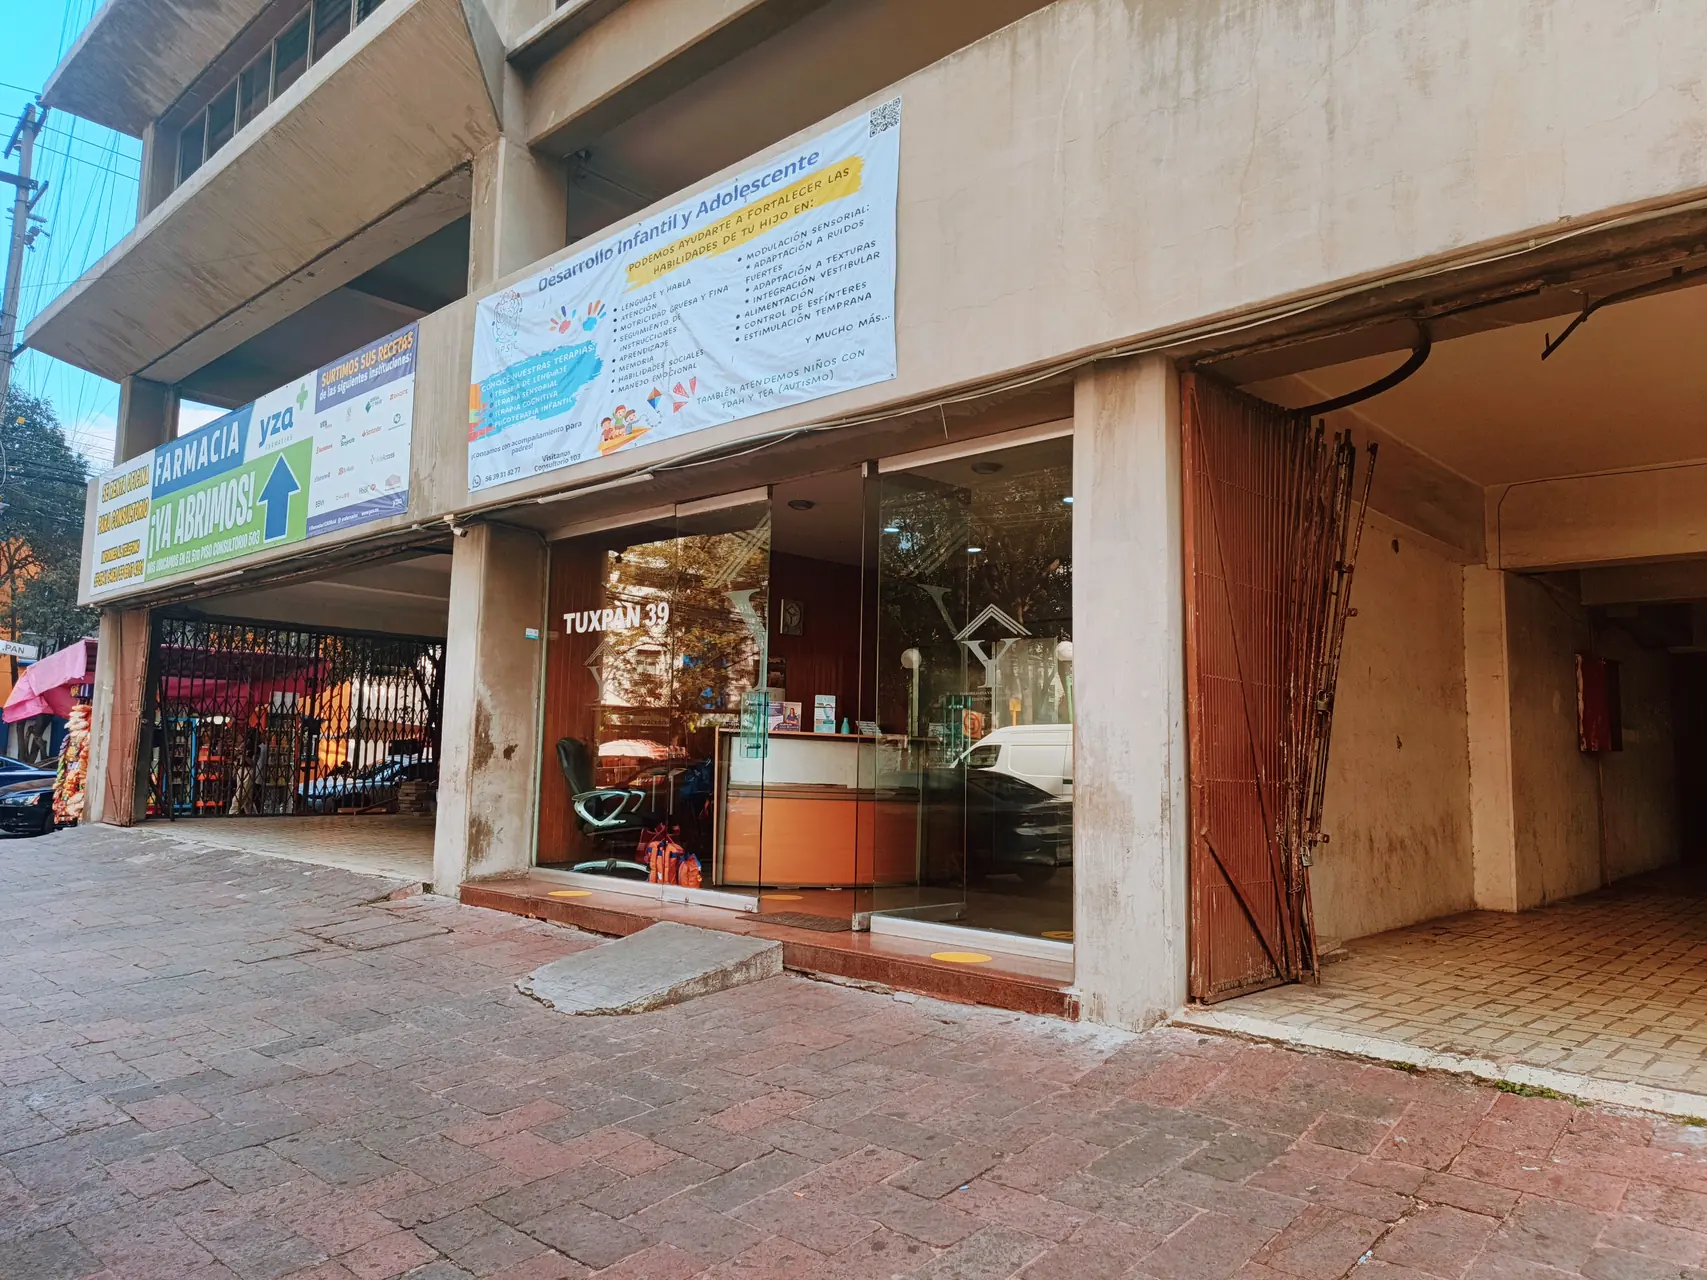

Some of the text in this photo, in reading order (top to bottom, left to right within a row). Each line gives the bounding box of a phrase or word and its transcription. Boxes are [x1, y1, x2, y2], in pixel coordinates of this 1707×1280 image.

[538, 151, 820, 292] Desarrollo Infantil y Adolescente
[628, 167, 850, 273] PODEMOS AYUDARTE A FORTALECER LAS
[653, 198, 814, 275] HABILIDADES DE TU HIJO EN:
[746, 204, 870, 260] MODULACIÓN SENSORIAL:
[753, 219, 864, 269] ADAPTACIÓN A RUIDOS
[745, 264, 783, 284] FUERTES
[752, 240, 876, 292] ADAPTACIÓN A TEXTURAS
[753, 251, 880, 304] INTEGRACIÓN VESTIBULAR
[620, 285, 729, 332] MOTRICIDAD GRUESA Y FINA
[621, 292, 657, 311] LENGUAJE
[666, 278, 692, 293] HABLA
[744, 287, 814, 318] ALIMENTACIÓN
[744, 281, 867, 330] CONTROL DE ESFÍNTERES
[620, 313, 681, 342] SEGUIMIENTO DE
[621, 303, 657, 322] ATENCIÓN
[744, 292, 872, 341] ESTIMULACIÓN TEMPRANA
[620, 326, 677, 351] INSTRUCCIONES
[805, 336, 812, 344] Y
[815, 323, 854, 342] MUCHO
[321, 331, 414, 387] SURTIMOS SUS RECETAS
[618, 349, 704, 383] HABILIDADES SOCIALES
[619, 340, 669, 362] APRENDIZAJE
[619, 355, 654, 372] MEMORIA
[319, 352, 412, 401] de las siguientes instituciones:
[481, 375, 512, 393] CONOCE
[512, 360, 551, 379] NUESTRAS
[494, 365, 568, 397] TERAPIA DE LENGUAJE
[618, 362, 697, 393] MANEJO EMOCIONAL
[696, 349, 865, 404] TAMBIÉN ATENDEMOS NIÑOS CON
[721, 369, 834, 409] TDAH Y TEA (AUTISMO)
[494, 380, 558, 408] TERAPIA SENSORIAL
[494, 390, 559, 417] TERAPIA COGNITIVA
[541, 396, 573, 411] INFANTIL
[258, 406, 294, 449] yza
[501, 442, 511, 451] con
[511, 427, 565, 446] acompañamiento
[565, 421, 583, 432] para
[154, 421, 239, 487] FARMACIA
[511, 442, 534, 456] padres!
[533, 453, 581, 472] Consultorio 103
[514, 466, 521, 474] 77
[102, 482, 110, 503] SE
[109, 474, 127, 500] RENTA
[149, 471, 256, 559] ¡YA ABRIMOS!
[200, 544, 213, 560] PISO
[213, 533, 248, 556] CONSULTORIO
[248, 530, 261, 546] 503
[564, 605, 641, 634] TUXPAN
[645, 601, 669, 627] 39
[1, 643, 25, 654] PAN
